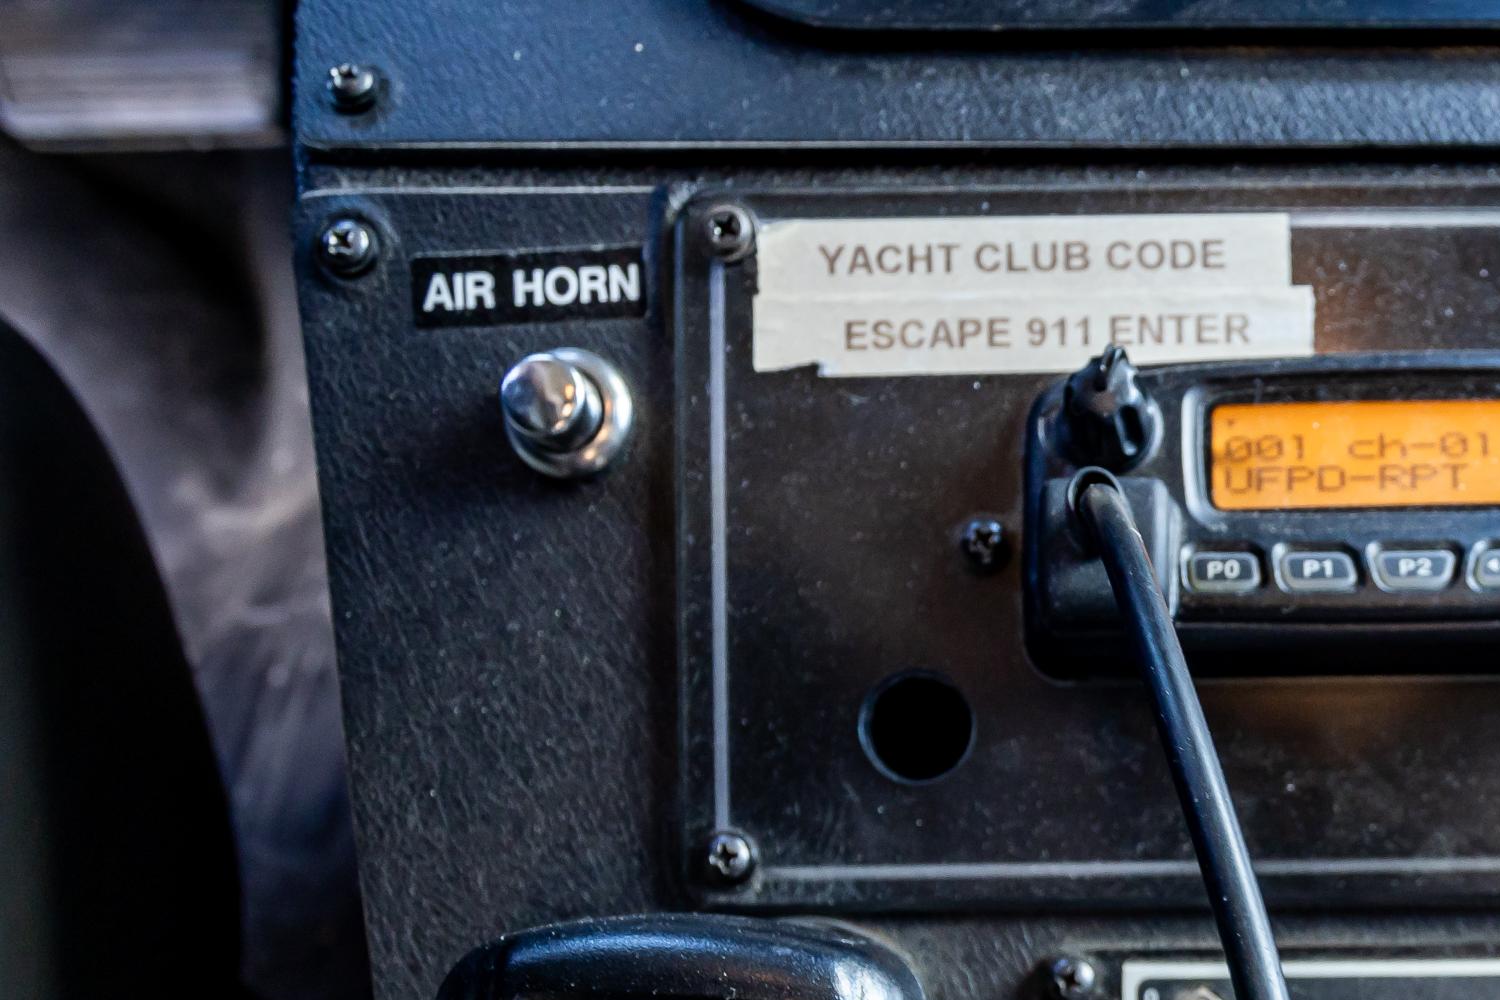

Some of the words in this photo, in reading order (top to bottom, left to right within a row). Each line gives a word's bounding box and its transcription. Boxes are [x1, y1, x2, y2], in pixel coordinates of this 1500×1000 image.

[819, 243, 960, 275] YACHT
[974, 240, 1090, 273] CLUB
[1106, 239, 1226, 271] CODE
[422, 270, 496, 312] AIR
[512, 263, 640, 307] HORN
[844, 317, 1011, 350] ESCAPE
[1026, 315, 1090, 346] 911
[1109, 313, 1251, 346] ENTER
[1225, 434, 1304, 463] 001
[1207, 558, 1241, 580] P0
[1303, 558, 1333, 578] P1
[1398, 557, 1432, 577] P2
